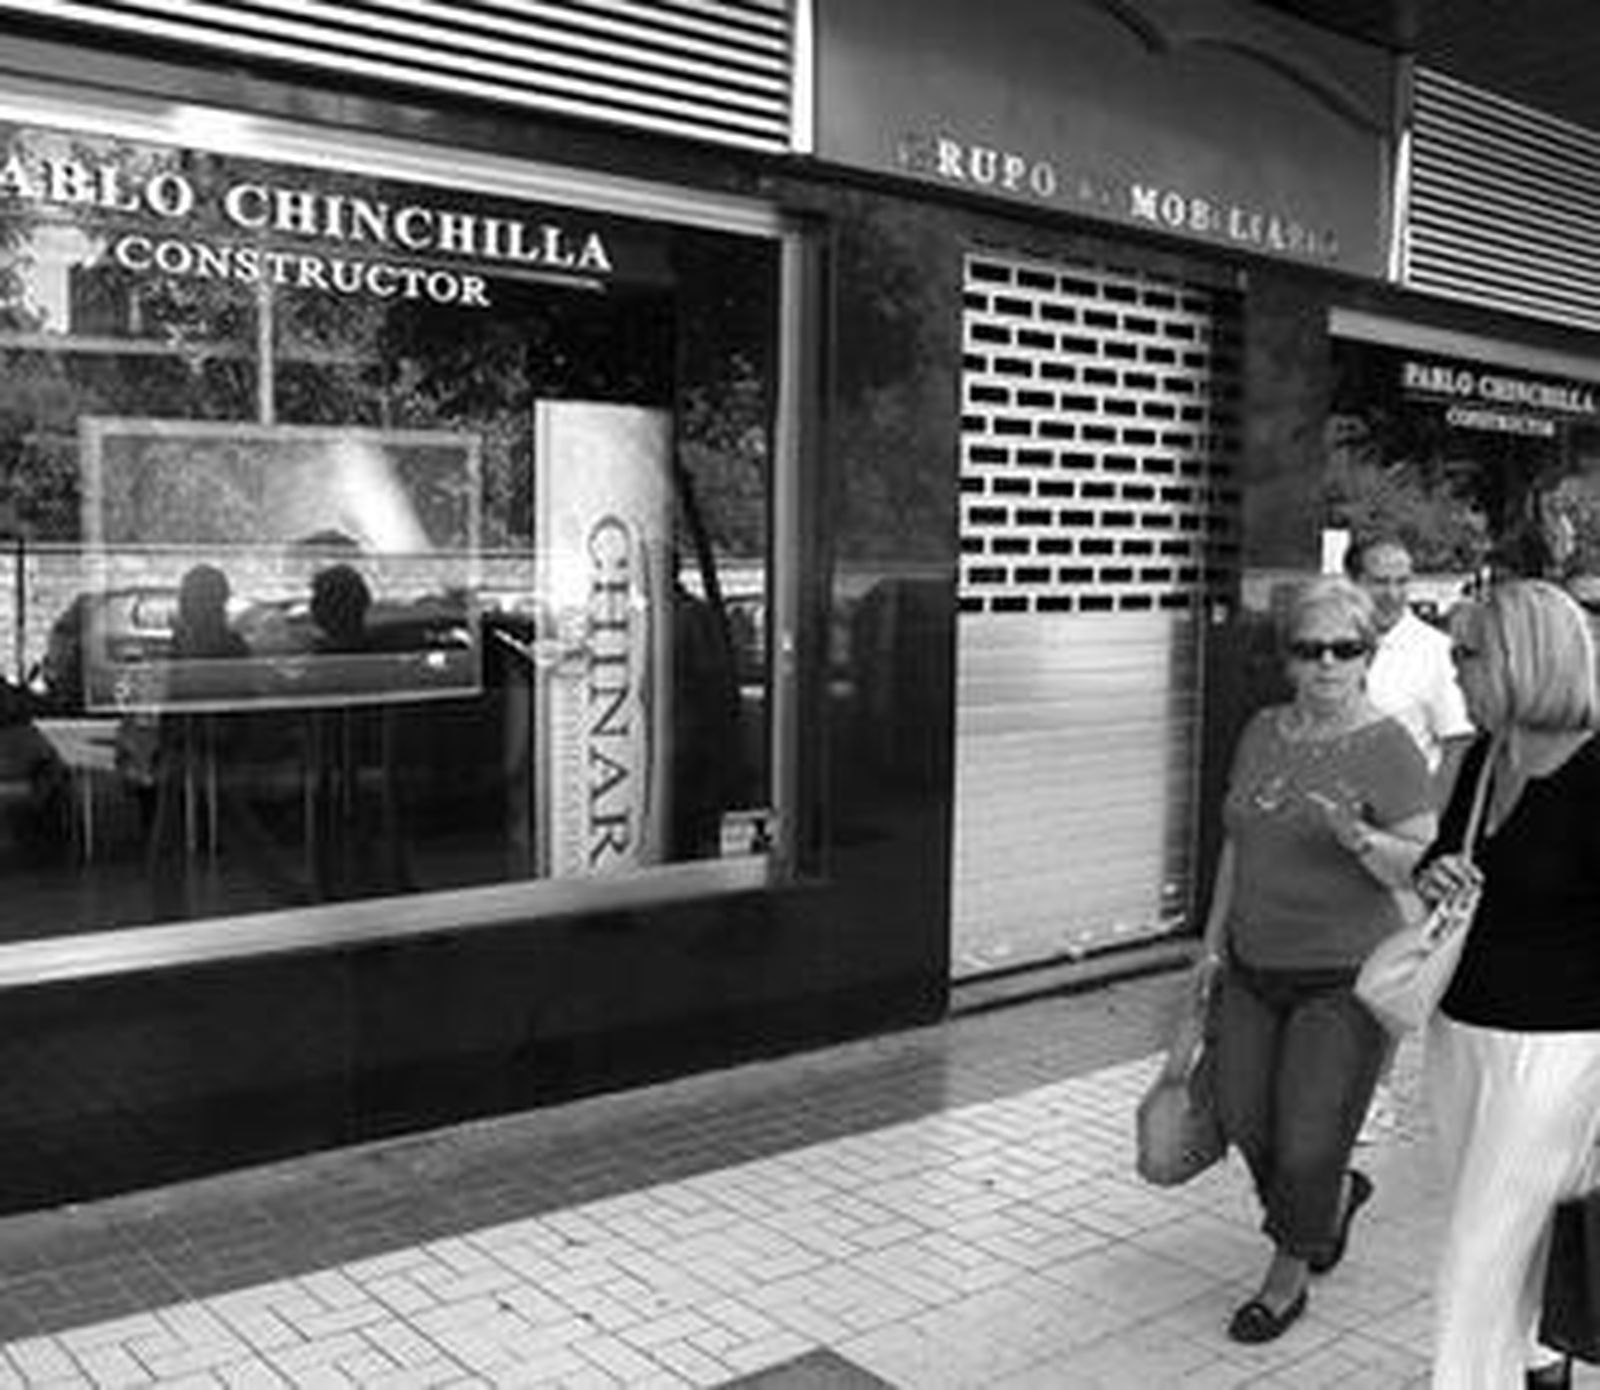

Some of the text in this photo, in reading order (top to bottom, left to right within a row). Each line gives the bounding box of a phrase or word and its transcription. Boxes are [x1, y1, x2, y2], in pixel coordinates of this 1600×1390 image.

[902, 138, 1056, 198] RUPO
[225, 183, 612, 272] CHINCHILLA
[115, 235, 492, 307] CONSTRUCTOR
[1404, 361, 1474, 396] PABLO
